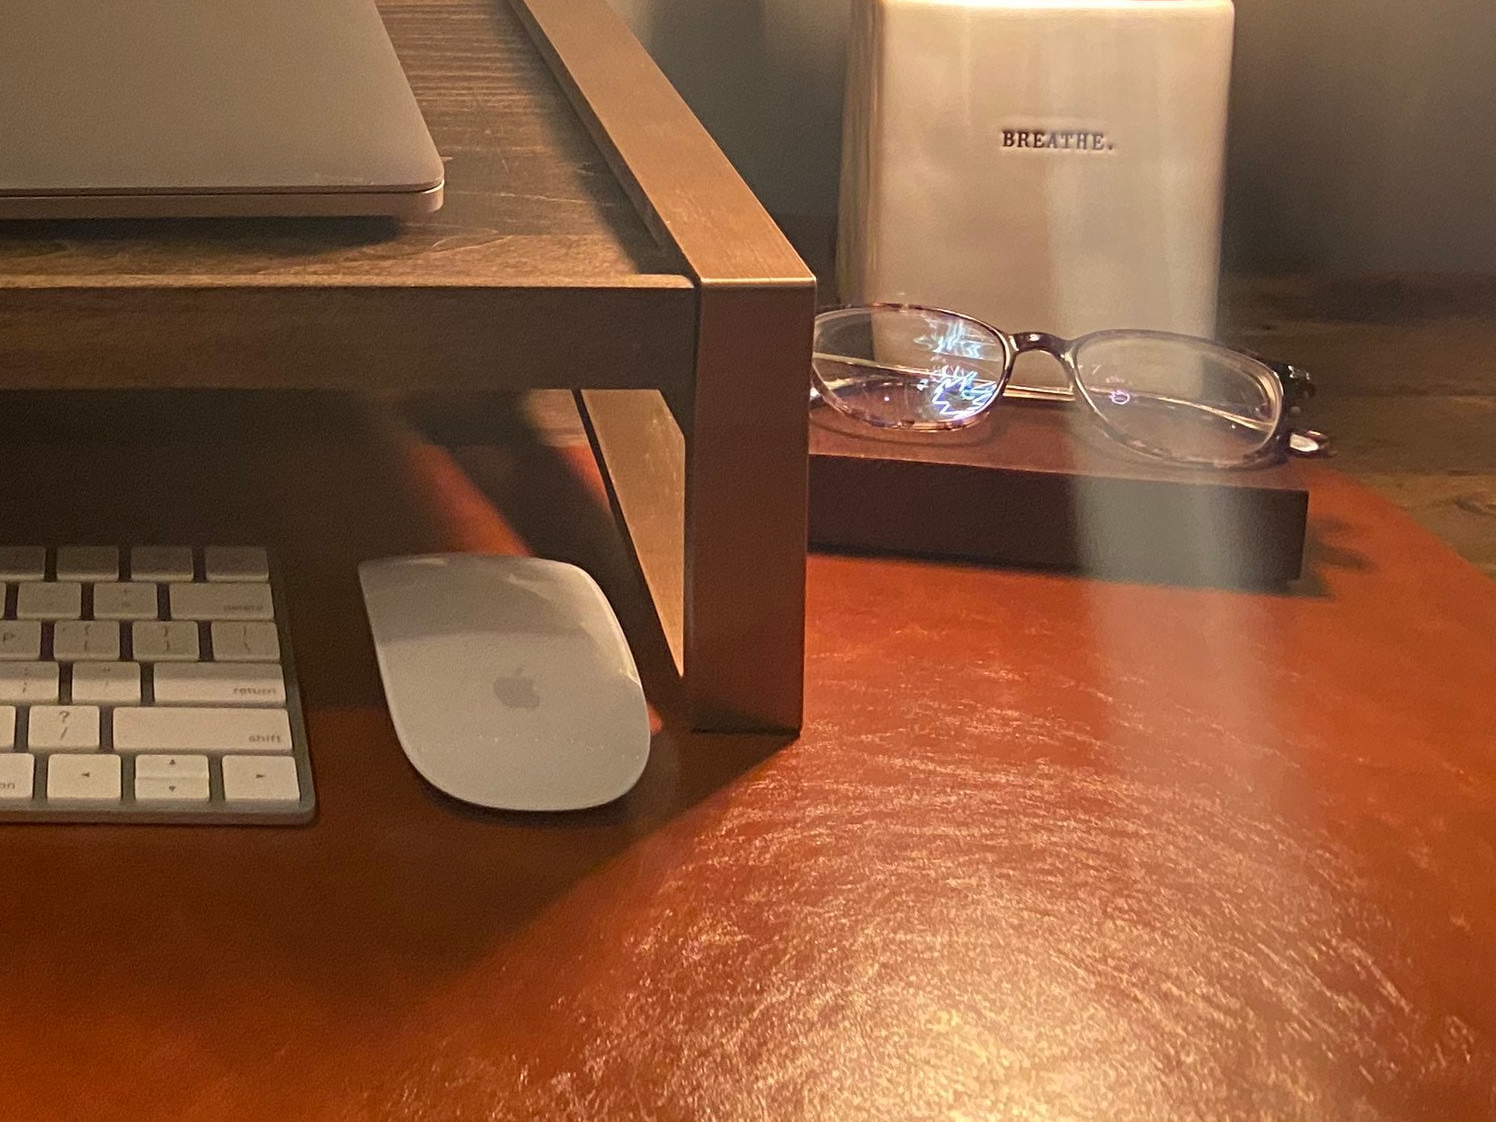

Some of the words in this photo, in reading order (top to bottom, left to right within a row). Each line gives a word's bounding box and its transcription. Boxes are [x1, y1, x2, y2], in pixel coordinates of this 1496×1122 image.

[1001, 129, 1114, 150] BREATHE.
[1, 631, 16, 644] P
[233, 686, 277, 696] return
[248, 732, 282, 744] shift
